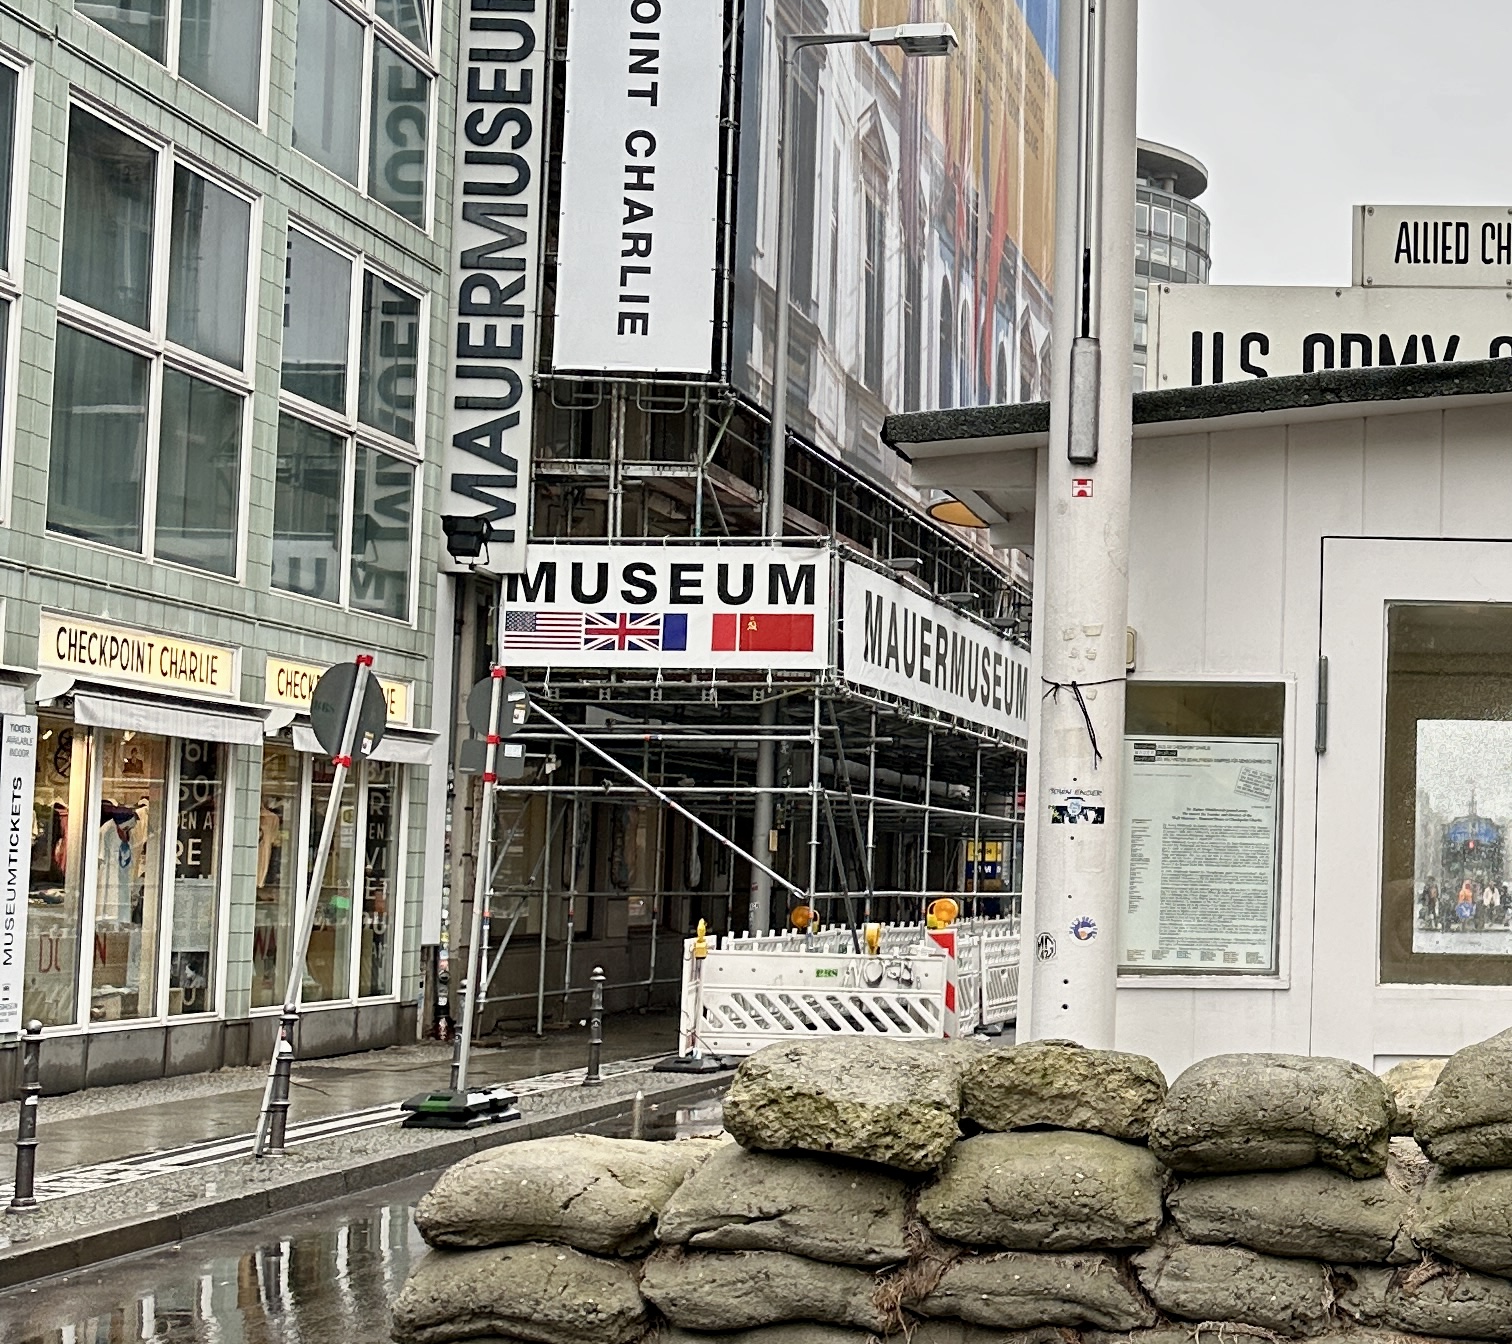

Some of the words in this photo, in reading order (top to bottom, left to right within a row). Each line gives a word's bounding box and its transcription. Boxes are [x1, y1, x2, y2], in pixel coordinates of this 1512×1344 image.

[616, 130, 657, 337] CHARLIE
[1394, 221, 1470, 265] ALLIED
[507, 562, 816, 606] MUSEUM
[56, 626, 155, 674] CHECKPOINT
[160, 645, 218, 686] CHARLIE
[863, 590, 1029, 722] MAUERMUSEUM
[2, 775, 23, 966] MUSEUMTICKETS
